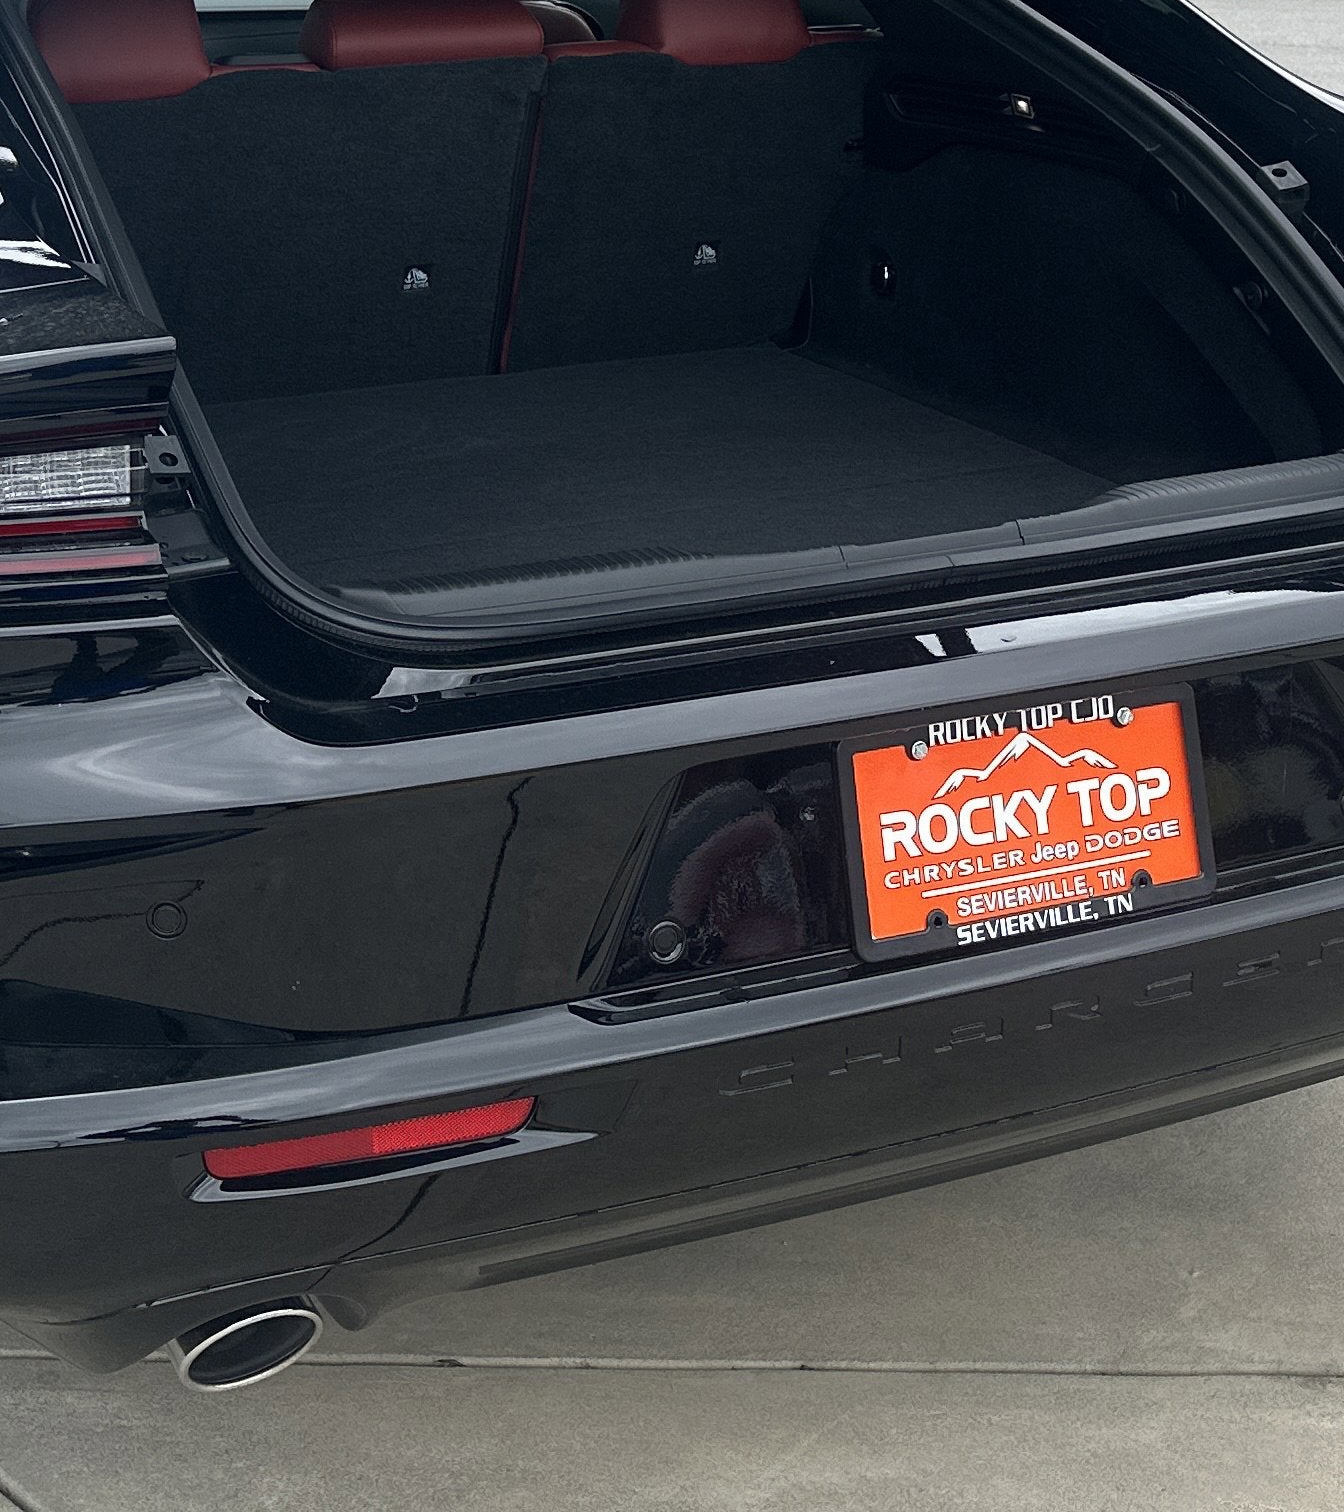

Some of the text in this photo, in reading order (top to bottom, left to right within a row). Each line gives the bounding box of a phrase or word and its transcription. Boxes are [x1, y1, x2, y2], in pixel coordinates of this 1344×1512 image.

[928, 711, 1008, 747] ROCKY
[1017, 703, 1064, 732] TOP
[879, 766, 1171, 862] ROCKY TOP
[884, 819, 1181, 889] CHRYSLER Jeep DODGE
[956, 867, 1127, 918] SEVIERVILLE, TN
[956, 892, 1134, 946] SEVIERVILLE, TN
